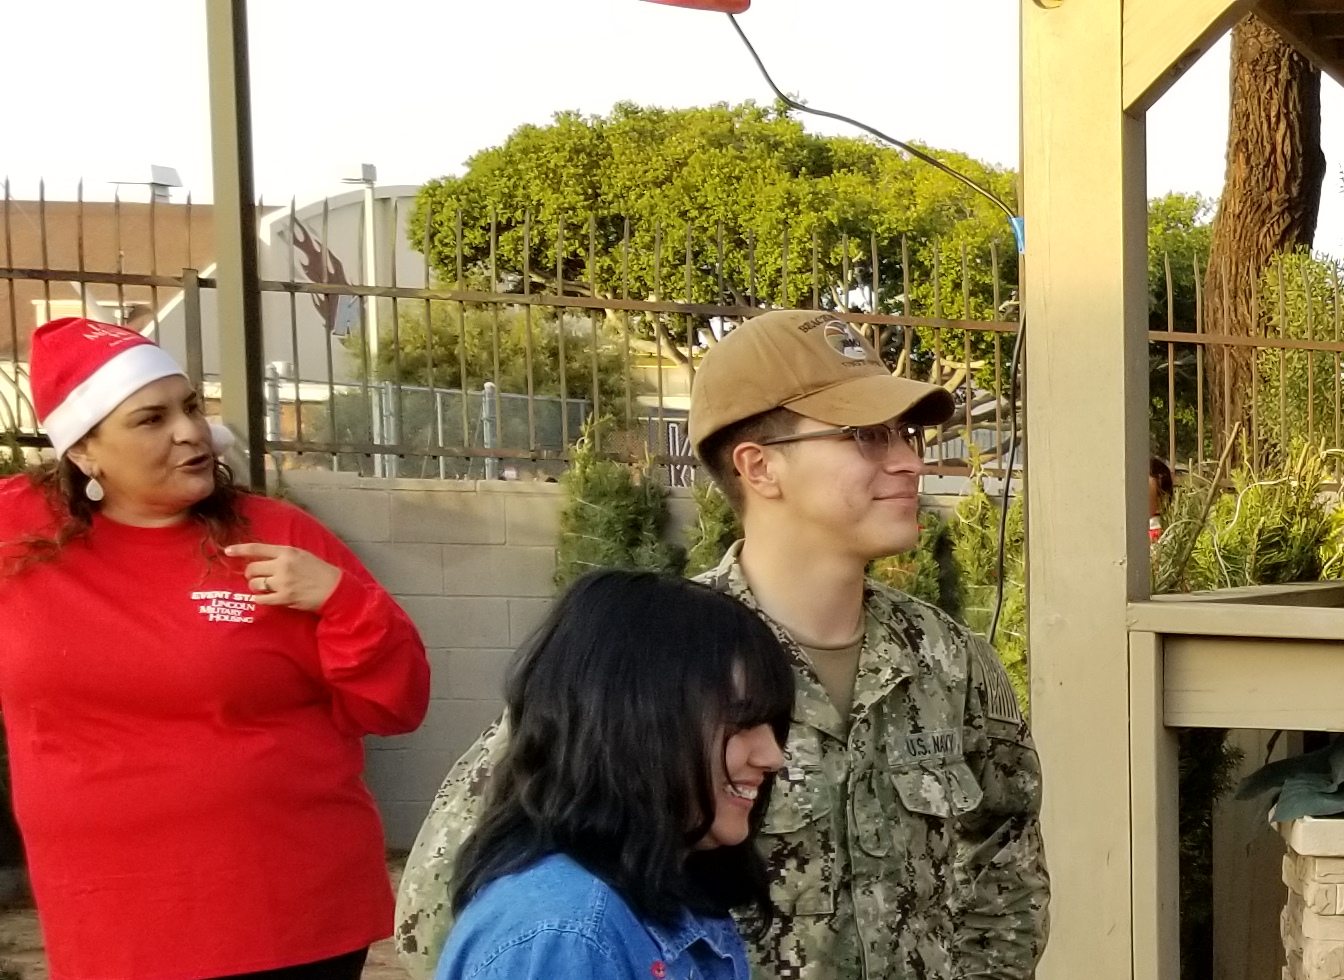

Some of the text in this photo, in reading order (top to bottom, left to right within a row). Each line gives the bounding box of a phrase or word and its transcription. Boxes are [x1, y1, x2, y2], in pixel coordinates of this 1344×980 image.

[191, 591, 232, 600] EVENT
[212, 599, 255, 611] LINCOLN
[199, 606, 243, 616] MILITARY
[208, 614, 254, 623] HOUSING
[906, 734, 955, 757] U.S. NAVY
